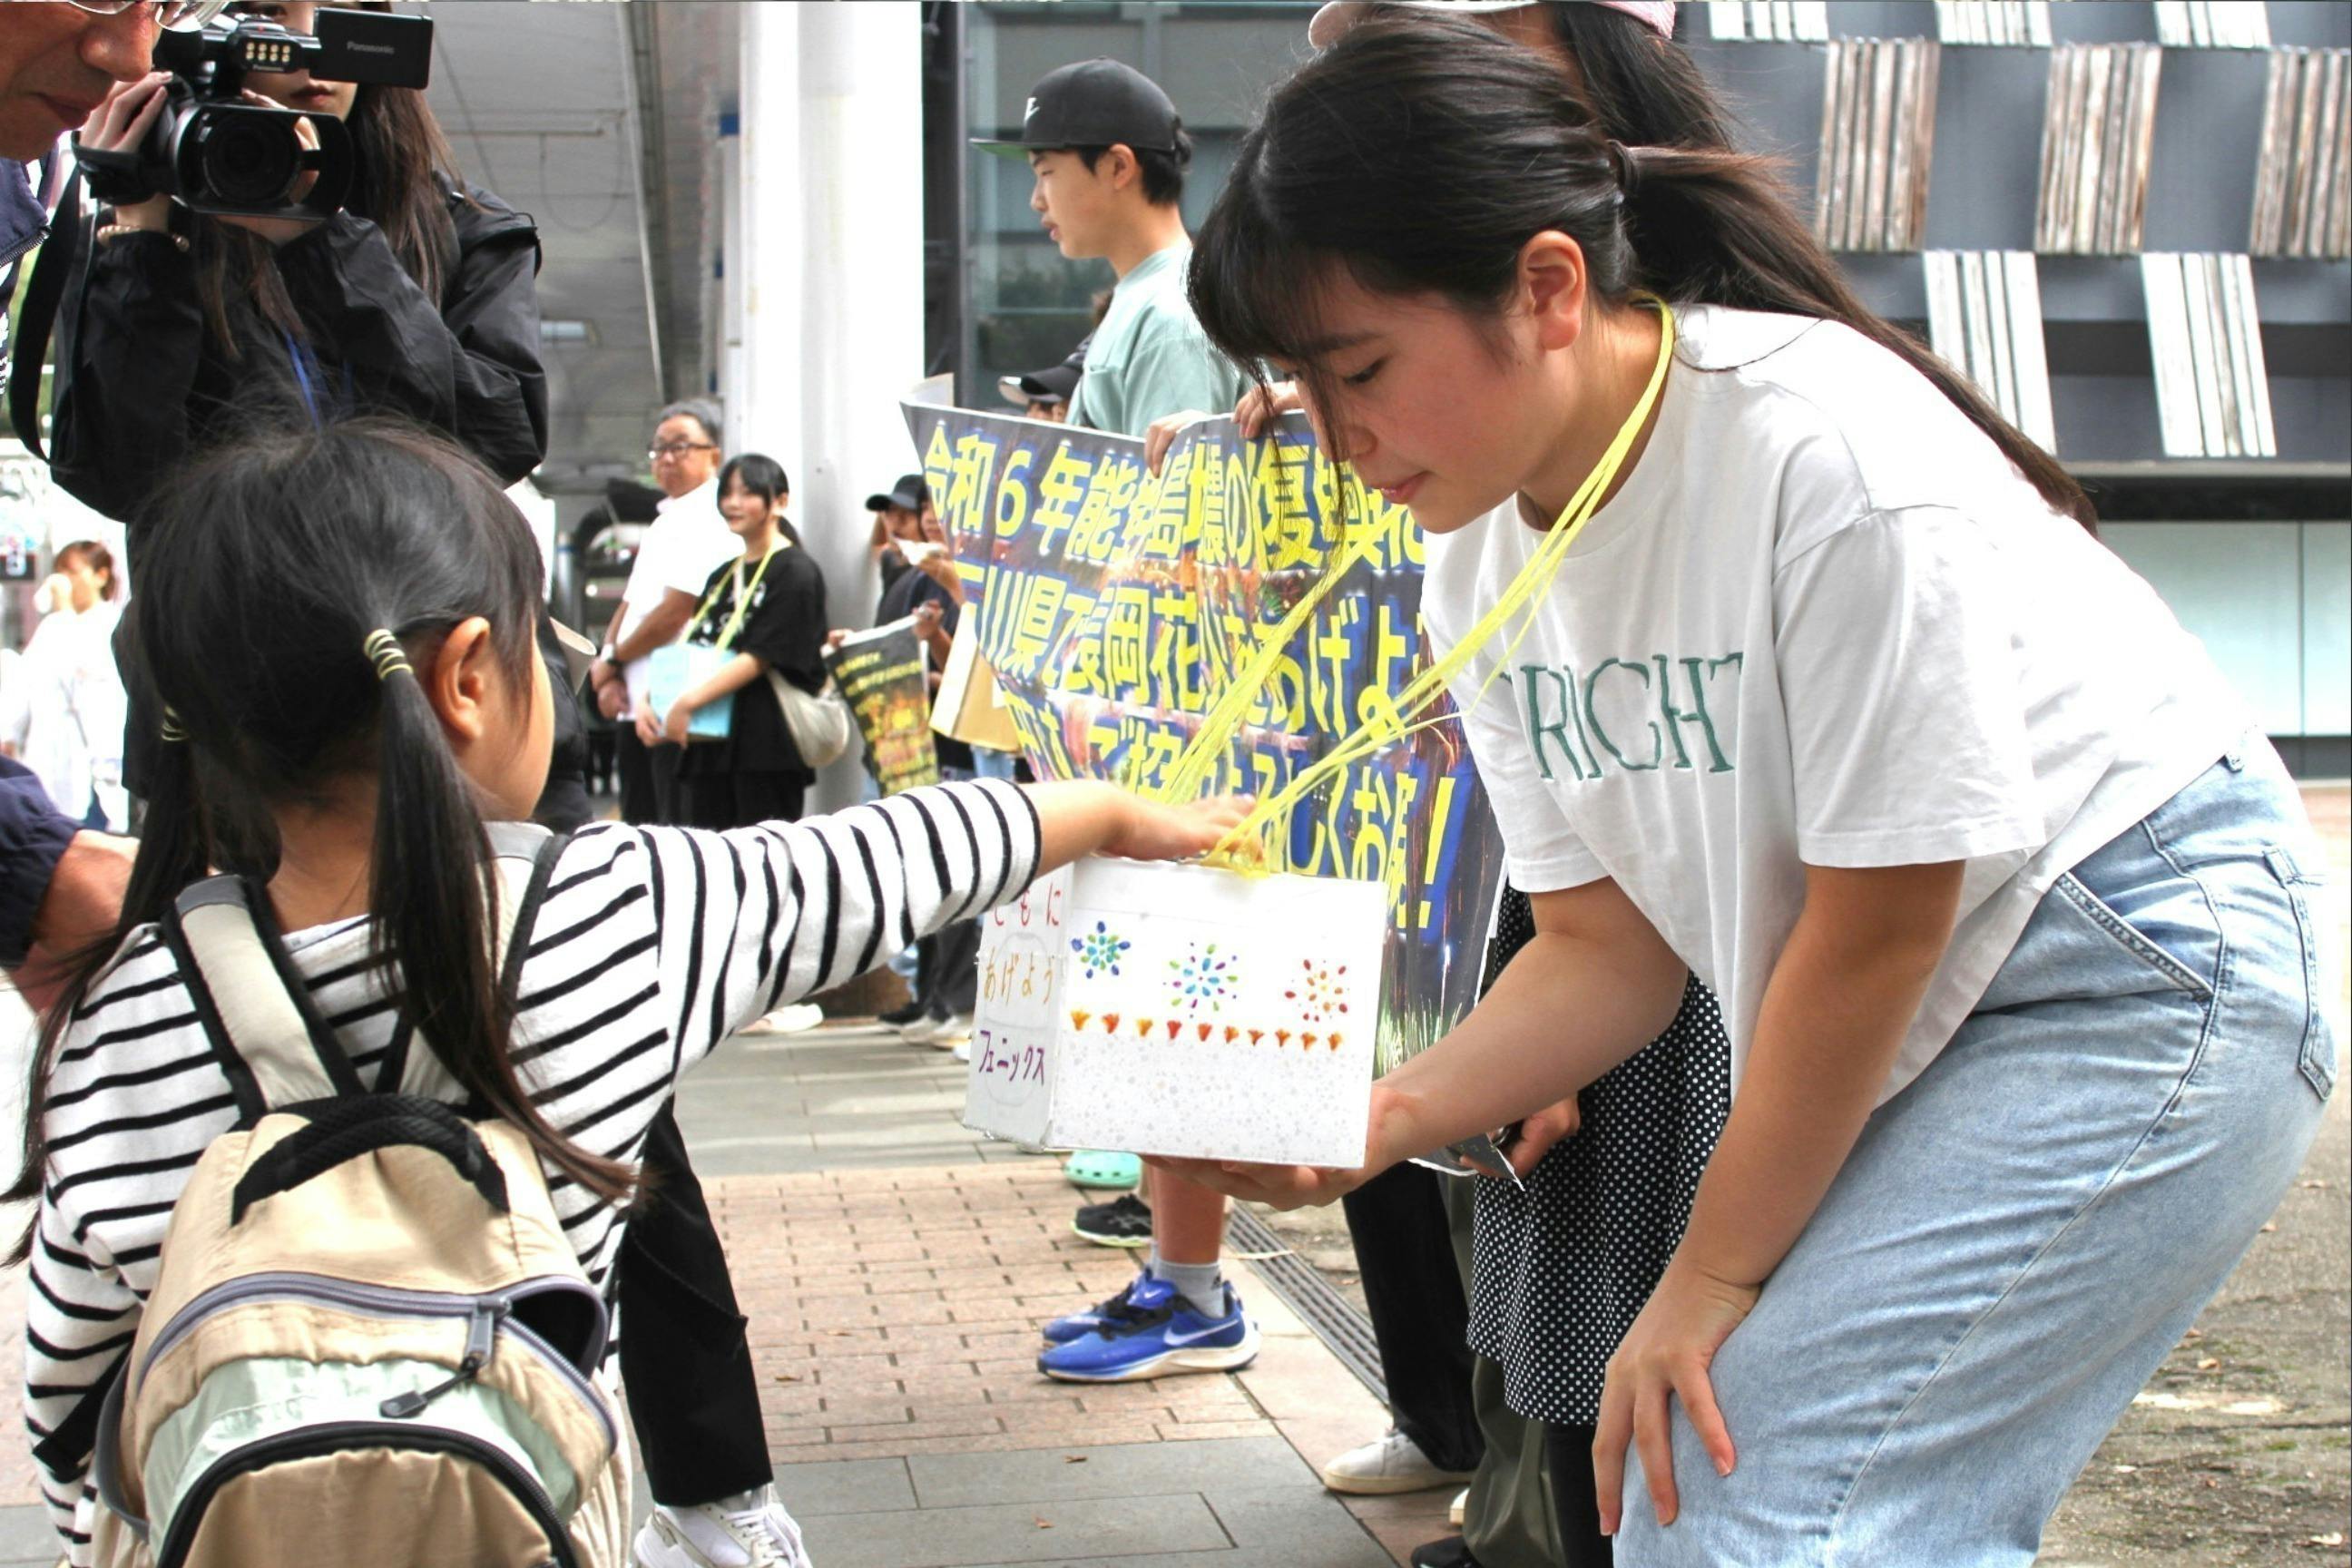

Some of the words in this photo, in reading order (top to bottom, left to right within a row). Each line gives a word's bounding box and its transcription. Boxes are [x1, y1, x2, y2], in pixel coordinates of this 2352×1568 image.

[346, 41, 396, 54] Panasonic
[1499, 652, 1744, 781] RIGH
[984, 947, 1055, 1005] あげよう
[979, 1030, 1045, 1086] フェニックス
